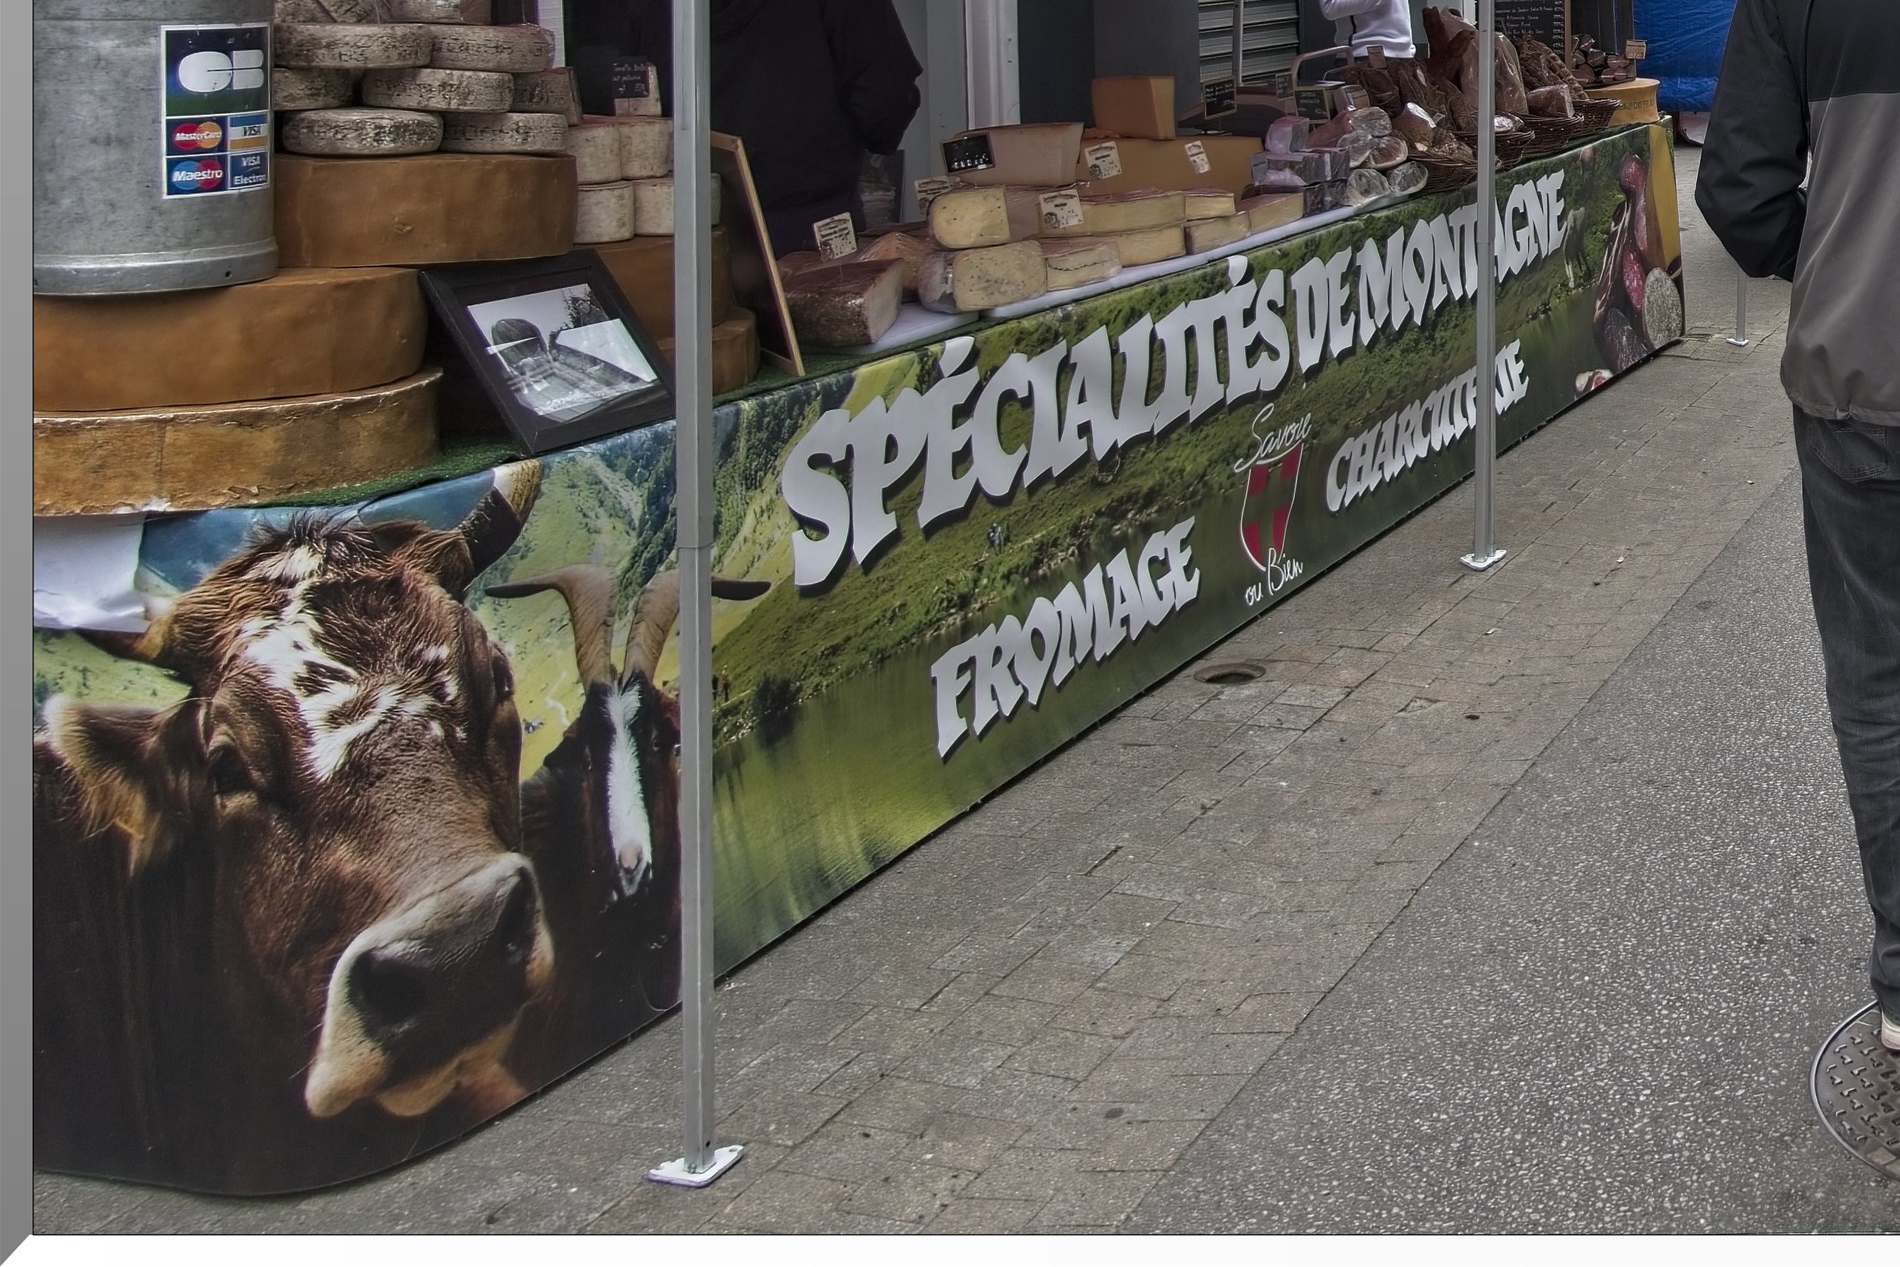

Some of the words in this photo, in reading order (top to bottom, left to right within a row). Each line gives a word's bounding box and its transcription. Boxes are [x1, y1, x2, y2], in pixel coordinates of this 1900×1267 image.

[175, 130, 222, 142] MasterCard
[243, 125, 262, 137] VISA
[241, 155, 261, 168] VISA
[171, 166, 224, 183] Maestro
[233, 172, 268, 186] Electron
[781, 254, 1290, 587] SPÉCIALITÉS
[1291, 246, 1356, 375] DE
[1245, 581, 1264, 606] ou
[1266, 546, 1304, 597] Bien
[930, 515, 1201, 759] FROMAGE
